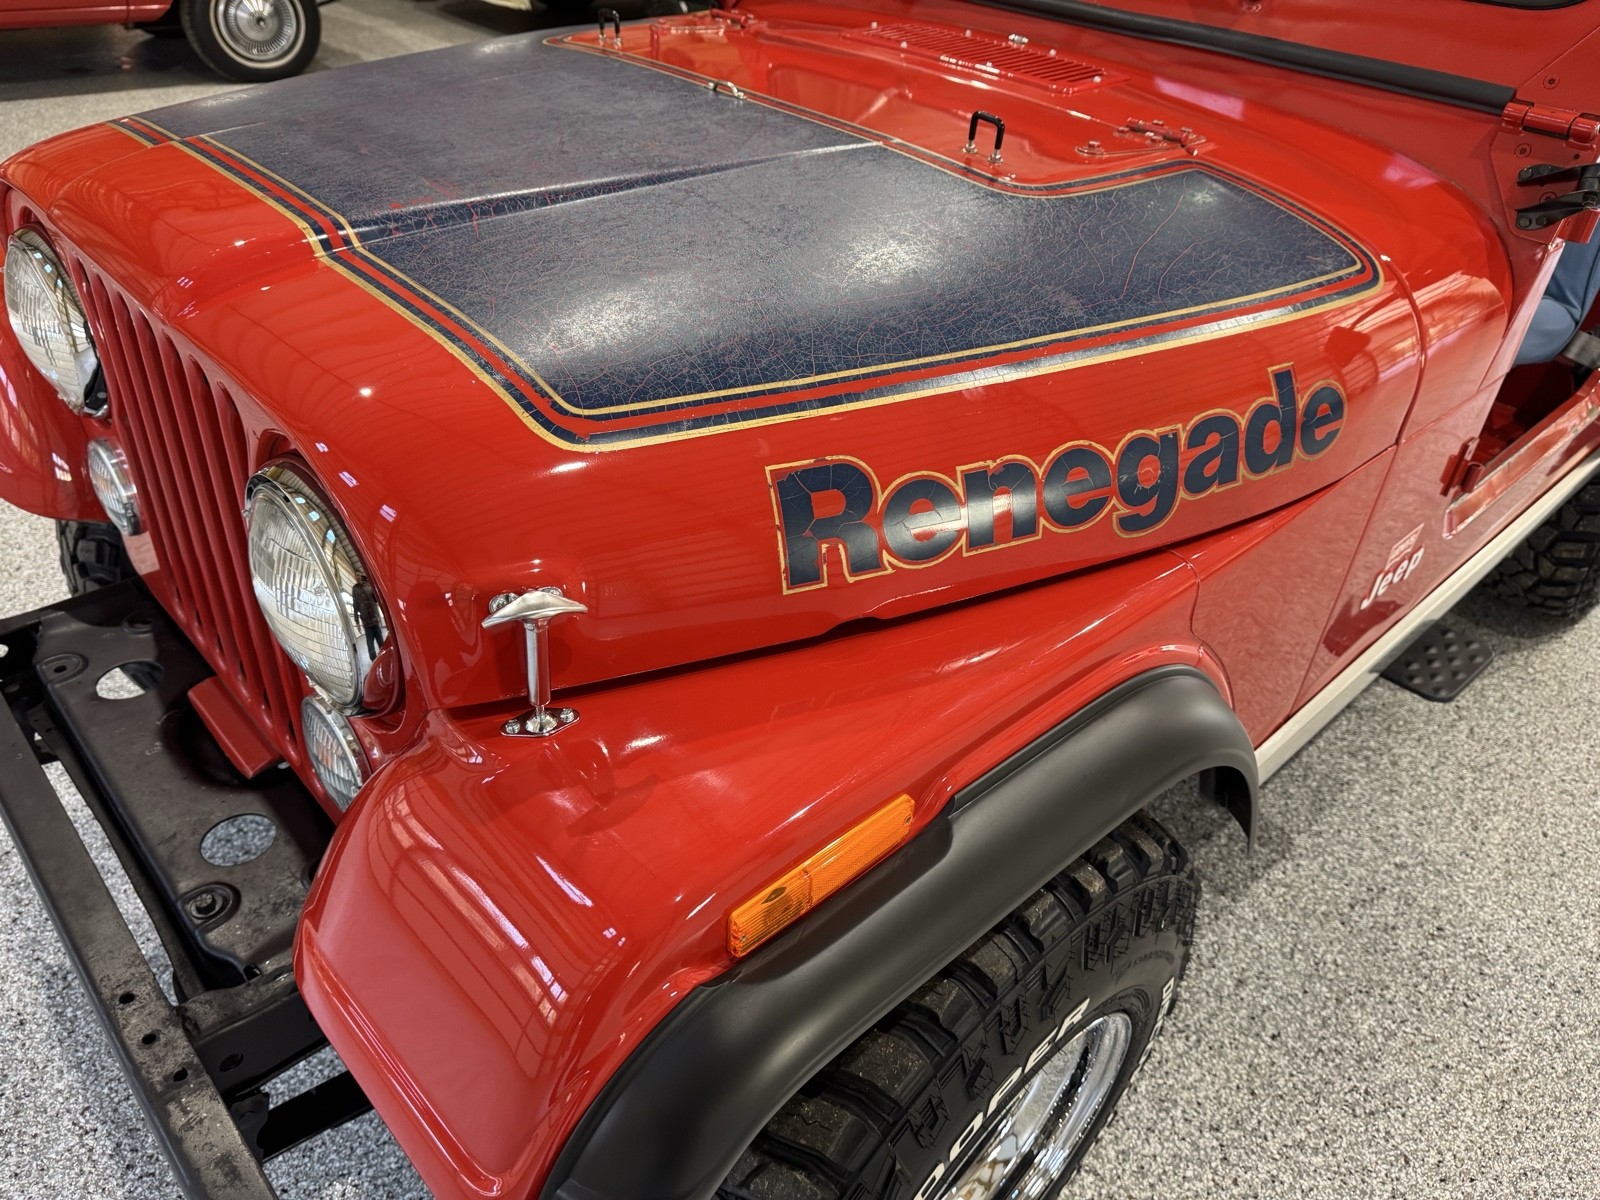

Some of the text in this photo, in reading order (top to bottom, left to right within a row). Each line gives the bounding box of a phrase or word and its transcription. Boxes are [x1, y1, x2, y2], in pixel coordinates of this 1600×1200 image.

[766, 362, 1347, 595] Renegade
[1360, 547, 1425, 611] Jeep
[913, 997, 1091, 1200] OOPER
